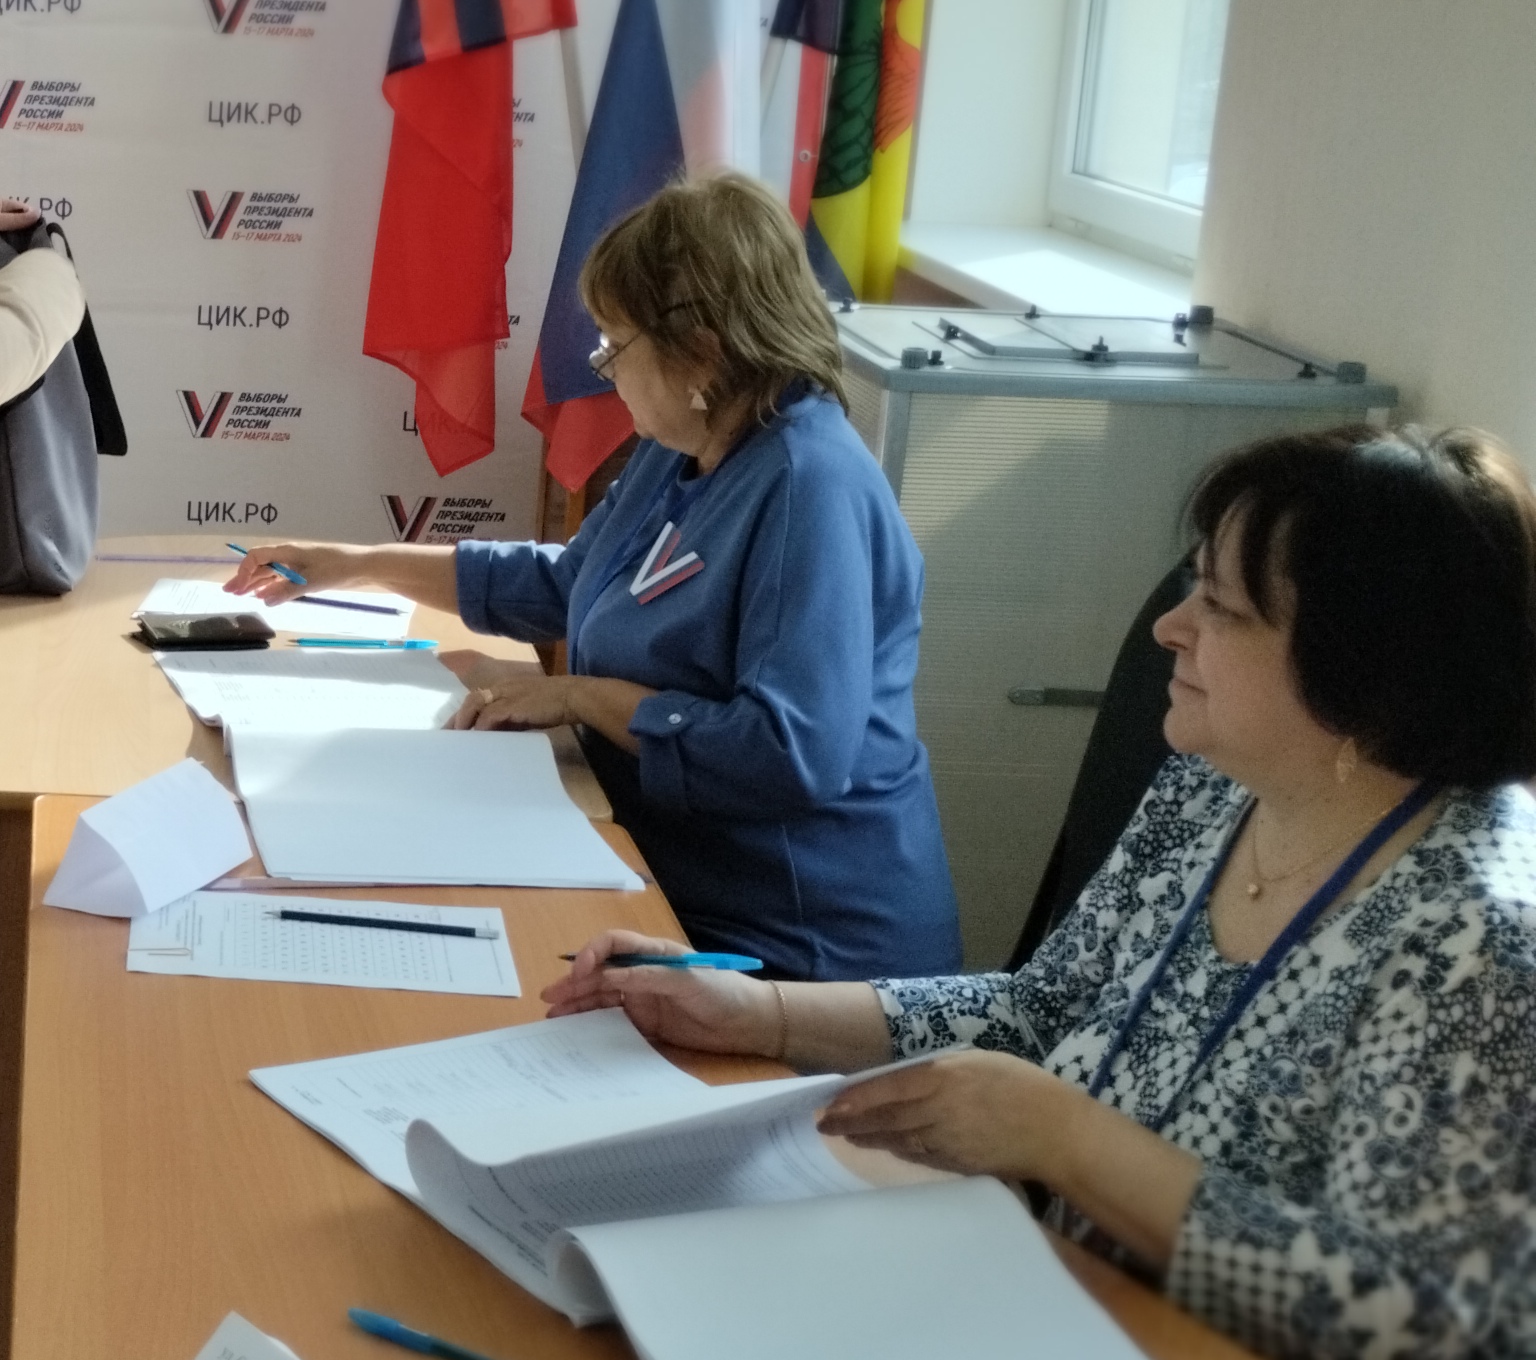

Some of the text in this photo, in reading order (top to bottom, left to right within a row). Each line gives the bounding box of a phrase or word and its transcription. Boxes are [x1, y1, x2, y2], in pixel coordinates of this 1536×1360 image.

[30, 80, 82, 92] ВЫБОРЫ
[24, 94, 96, 108] ПРЕЗИДЕНТА
[18, 108, 64, 119] РОССИИ
[208, 101, 302, 128] ЦИК.РФ
[249, 192, 300, 204] ВЫБОРЫ
[243, 205, 314, 218] ПРЕЗИДЕНТА
[237, 219, 283, 230] РОССИИ
[197, 305, 290, 331] ЦИК.РФ
[238, 392, 289, 404] ВЫБОРЫ
[232, 405, 302, 418] ПРЕЗИДЕНТА
[225, 419, 271, 430] РОССИИ
[442, 497, 493, 509] ВЫБОРЫ
[187, 501, 278, 526] ЦИК.РФ
[436, 510, 506, 522] ПРЕЗИДЕНТА
[430, 523, 475, 534] РОССИИ
